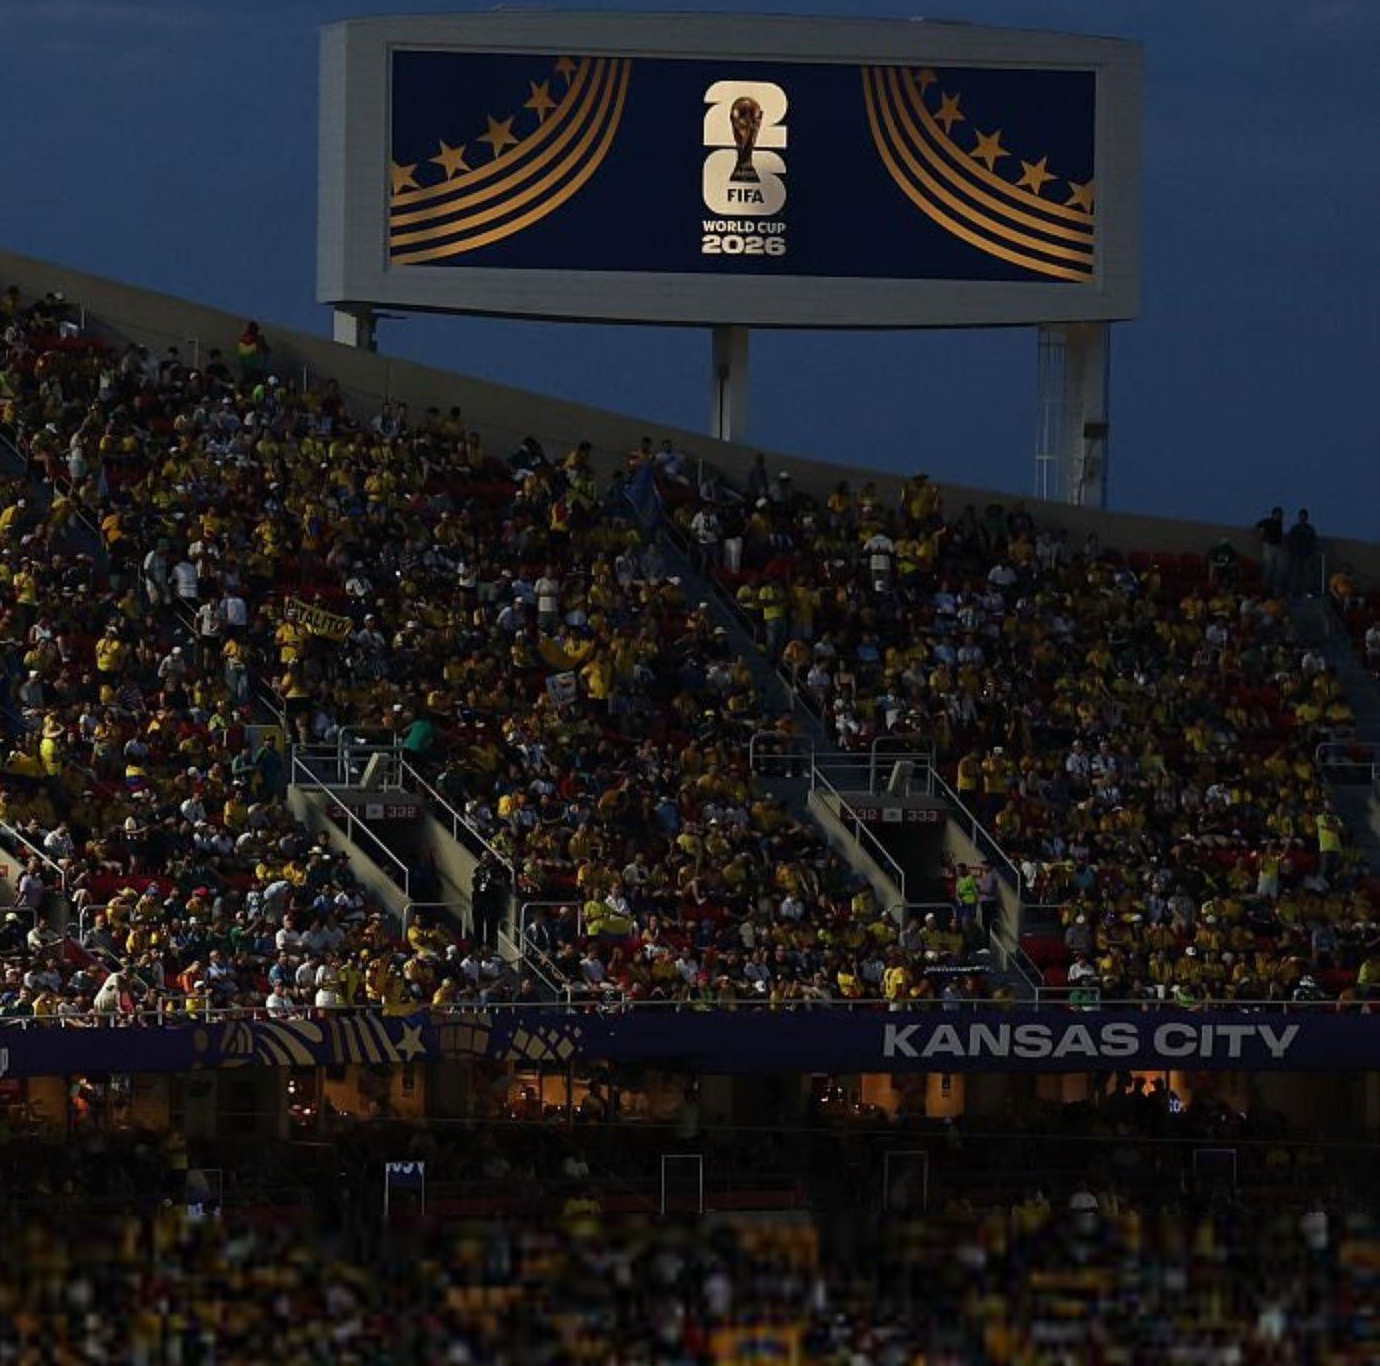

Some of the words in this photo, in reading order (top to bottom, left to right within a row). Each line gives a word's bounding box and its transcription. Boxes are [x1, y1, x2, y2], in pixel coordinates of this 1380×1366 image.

[727, 189, 764, 203] FIFA
[701, 220, 755, 233] WORLD
[758, 222, 787, 234] CUP
[701, 235, 787, 256] 2026
[882, 1022, 1140, 1059] KANSAS
[1152, 1022, 1301, 1059] CITY
